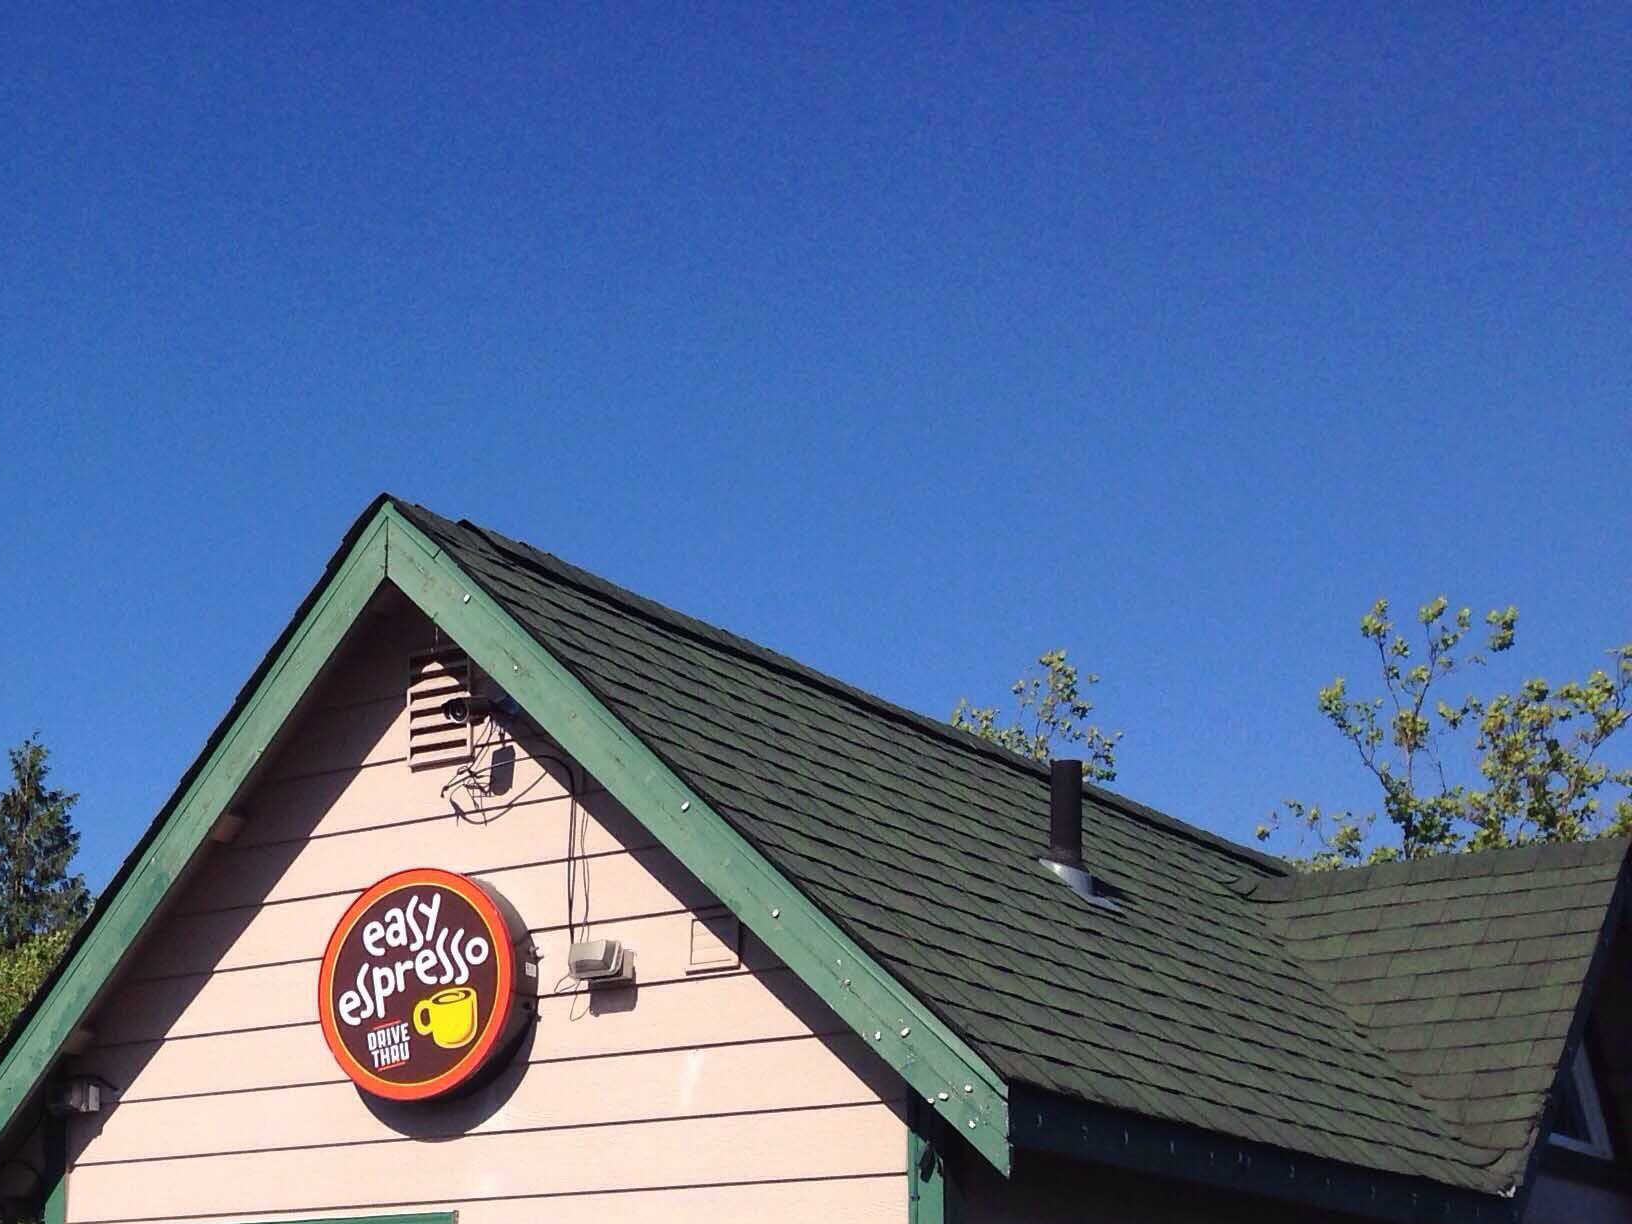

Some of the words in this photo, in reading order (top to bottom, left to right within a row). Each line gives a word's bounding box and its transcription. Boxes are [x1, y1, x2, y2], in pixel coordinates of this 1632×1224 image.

[363, 893, 441, 956] easy
[339, 927, 489, 1026] espresso
[368, 1023, 410, 1051] DRIVE
[371, 1042, 410, 1069] THRU
